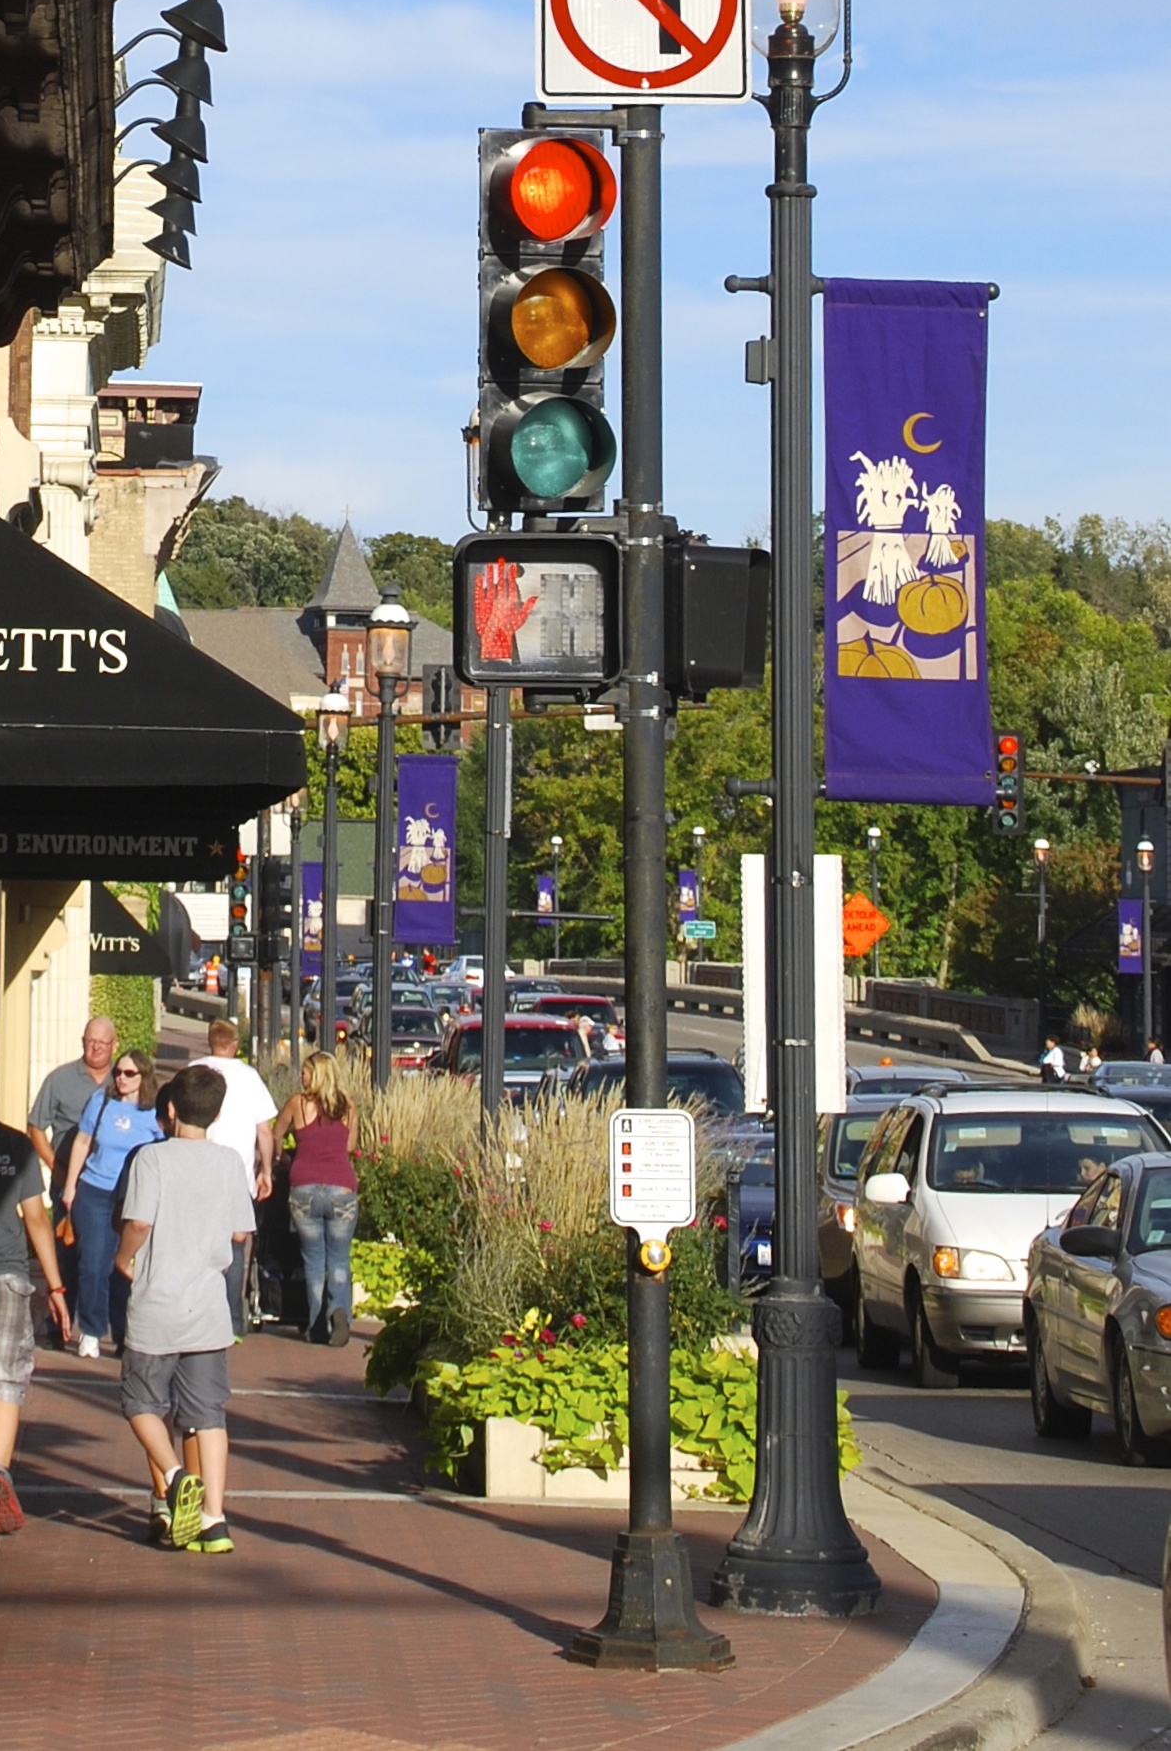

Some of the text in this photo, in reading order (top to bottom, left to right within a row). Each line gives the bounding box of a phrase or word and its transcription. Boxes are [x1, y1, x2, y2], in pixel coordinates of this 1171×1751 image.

[16, 833, 198, 857] ENVIRONMENT
[844, 910, 876, 919] DETOUR
[846, 923, 876, 931] AHEAD
